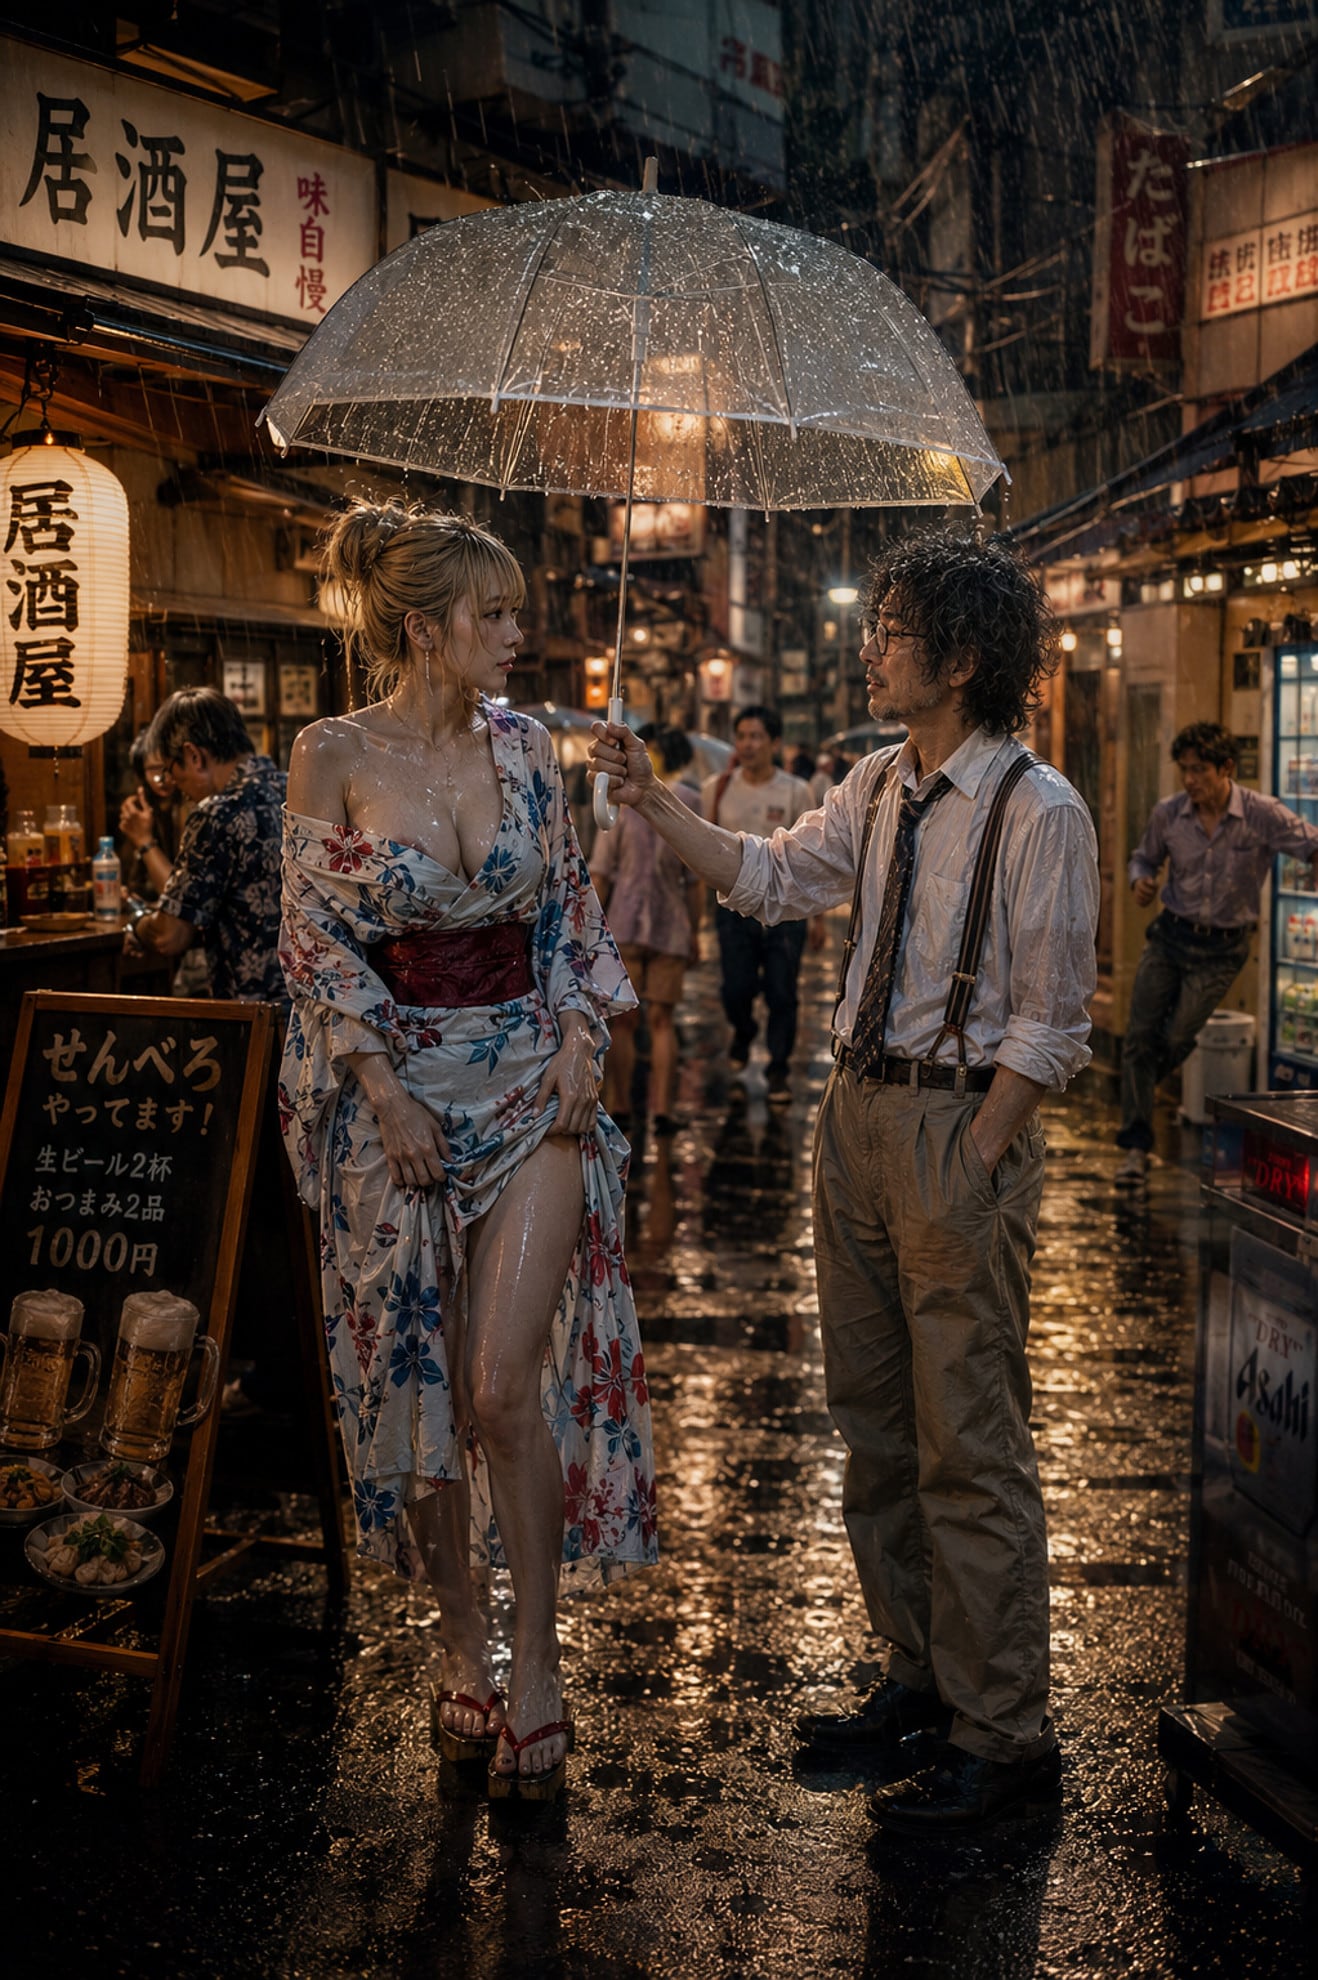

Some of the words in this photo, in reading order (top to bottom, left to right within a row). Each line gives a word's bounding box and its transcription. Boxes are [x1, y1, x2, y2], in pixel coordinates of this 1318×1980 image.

[20, 92, 271, 278] 居酒屋
[296, 173, 329, 314] 味自慢
[1122, 149, 1178, 335] たばこ
[4, 481, 81, 709] 居酒屋
[43, 1028, 223, 1092] せんべろ
[42, 1093, 214, 1136] やってます！
[34, 1145, 173, 1180] 生ビール2杯
[29, 1185, 165, 1222] おつまみ2品
[27, 1225, 158, 1277] 1000円
[1237, 1348, 1308, 1441] Asahi
